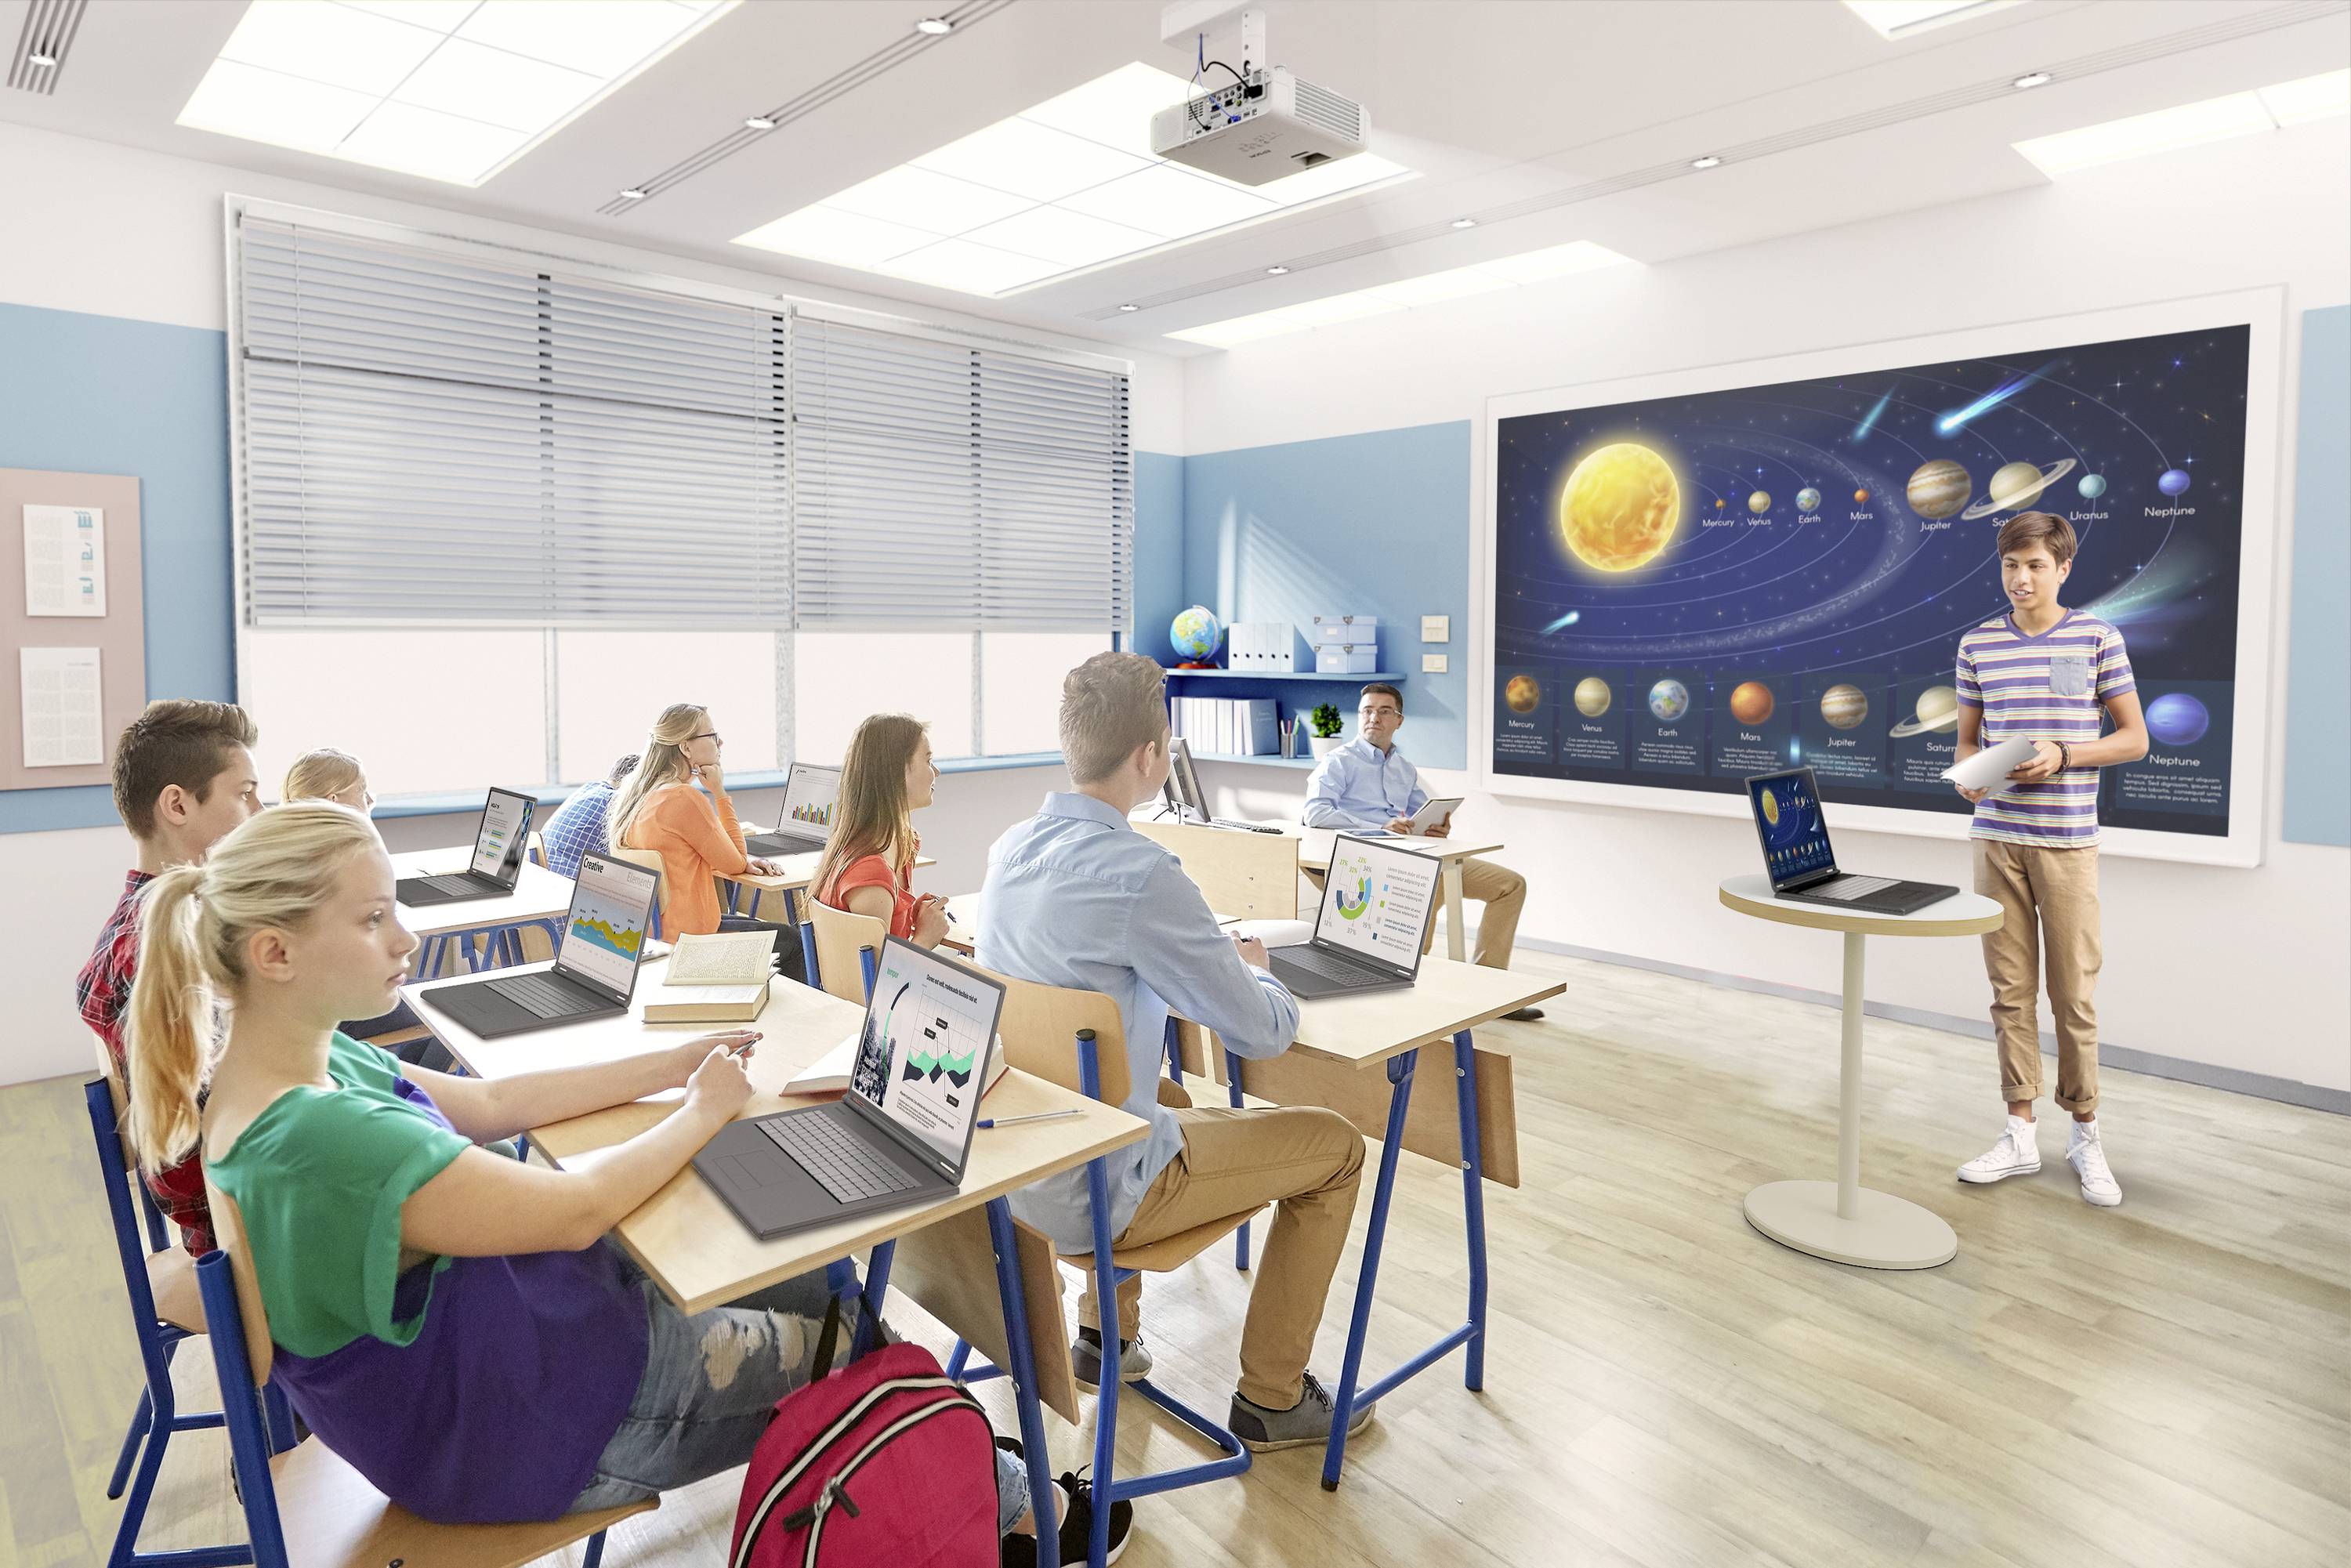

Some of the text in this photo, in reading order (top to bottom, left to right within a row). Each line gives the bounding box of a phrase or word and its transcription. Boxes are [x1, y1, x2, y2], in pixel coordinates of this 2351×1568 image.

[1849, 511, 1874, 520] Mars
[2070, 511, 2109, 521] Uranus
[2144, 506, 2196, 518] Neptune
[1702, 519, 1735, 527] Mercury
[1747, 517, 1772, 526] Venus
[1798, 514, 1821, 523] Earth
[1920, 521, 1951, 532] Jupiter
[1509, 719, 1534, 730] Mercury
[1581, 723, 1603, 732] Venus
[1657, 727, 1678, 737] Earth
[1741, 732, 1762, 741] Mars
[1828, 737, 1856, 748] Jupiter
[1926, 742, 1958, 752] Saturn
[2149, 755, 2201, 766] Neptune
[583, 857, 604, 874] Creative
[627, 871, 653, 889] Elements
